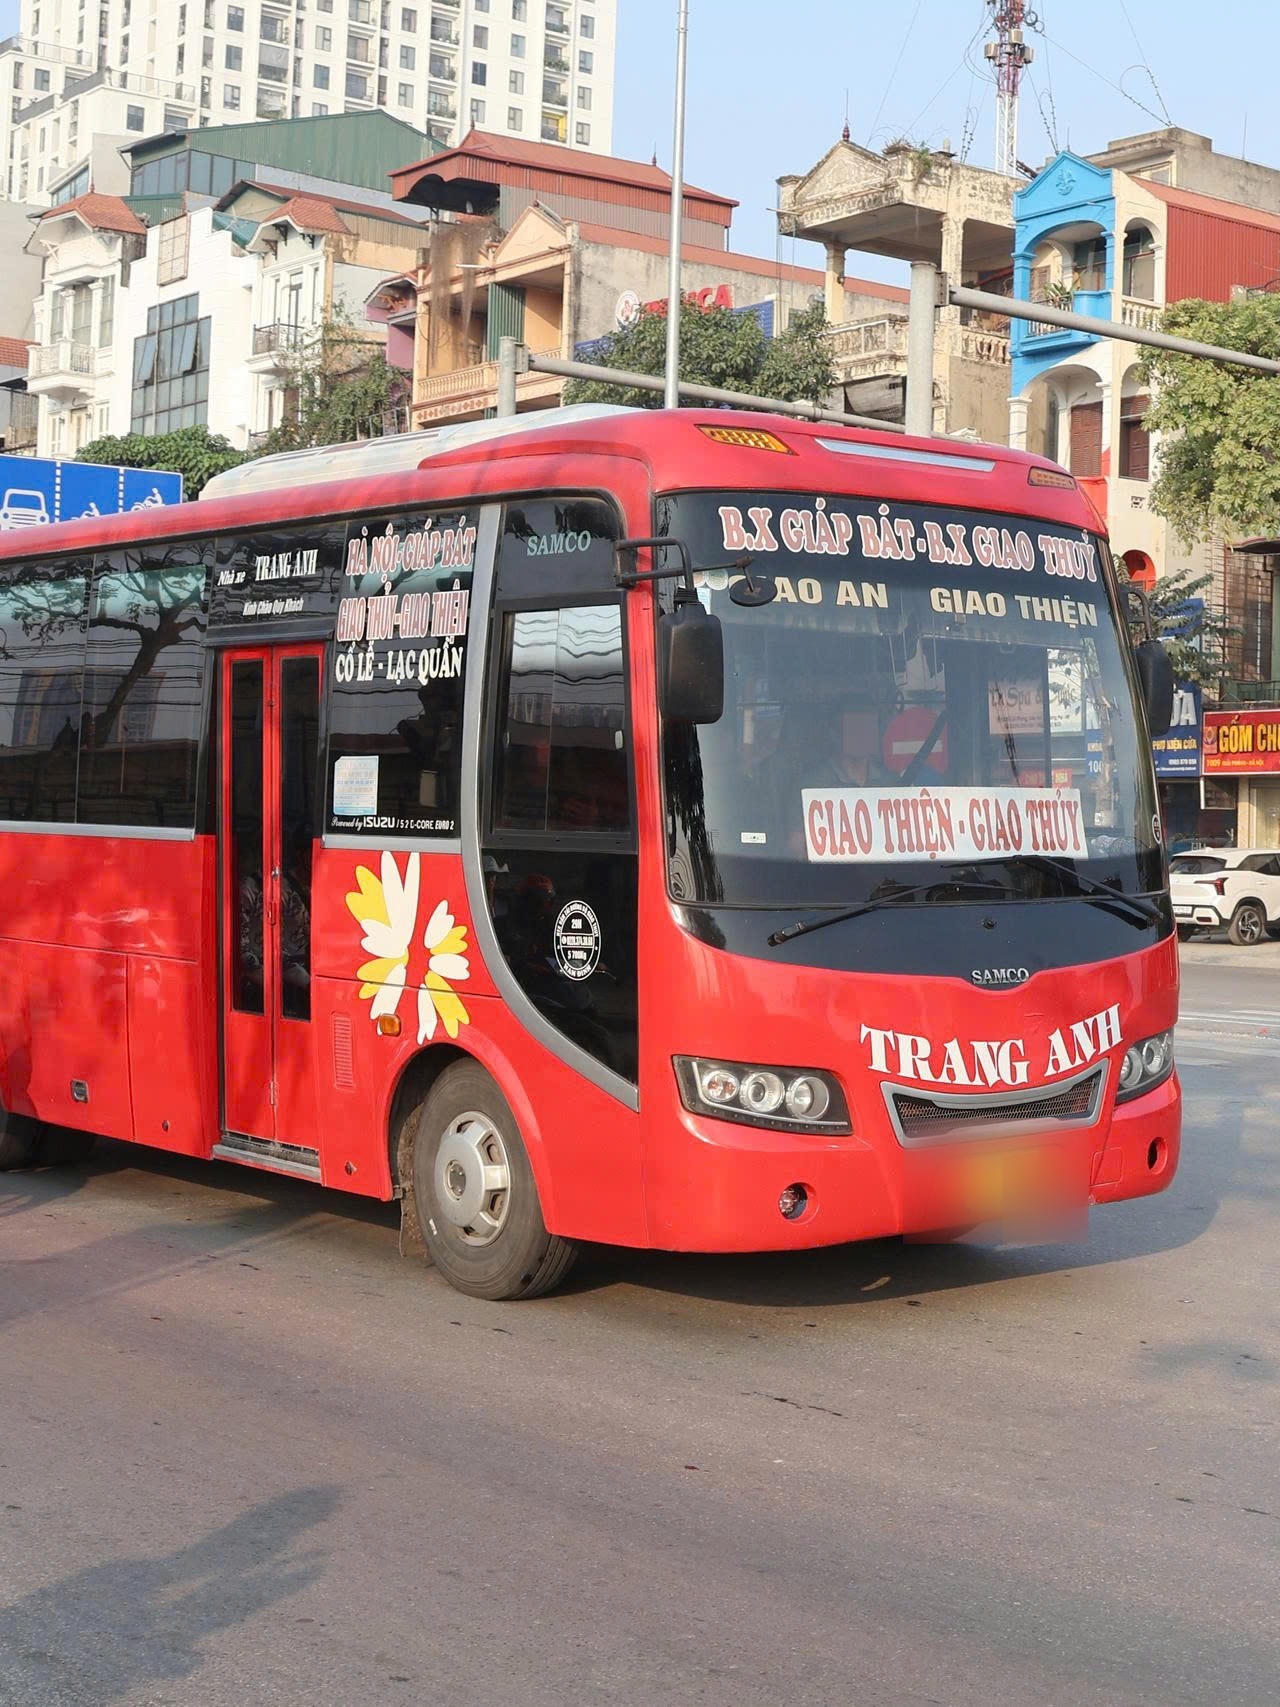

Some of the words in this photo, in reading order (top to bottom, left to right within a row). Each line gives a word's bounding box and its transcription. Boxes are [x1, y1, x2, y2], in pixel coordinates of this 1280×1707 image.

[345, 526, 368, 576] HÀ
[441, 515, 477, 568] BÁT
[526, 530, 592, 557] SAMCO
[718, 505, 779, 551] B.X
[779, 497, 854, 555] GIÁP
[972, 524, 1035, 571] GIAO
[217, 569, 235, 586] Nhà
[234, 571, 247, 584] xe
[254, 552, 293, 581] TRANG
[292, 548, 319, 577] ANH
[336, 596, 367, 642] GIAO
[430, 578, 470, 645] THIỆN
[836, 578, 889, 609] AN
[929, 586, 1006, 618] GIAO
[1014, 593, 1099, 629] THIỆN
[386, 650, 417, 685] LẠC
[1218, 714, 1254, 754] GỐM
[363, 816, 396, 828] ISUZU
[808, 797, 873, 857] GIAO
[877, 787, 955, 860] THIỆN
[968, 797, 1023, 853] GIAO
[971, 967, 1030, 985] SAMCO
[859, 1023, 1030, 1089] TRANG
[1044, 1002, 1124, 1077] ANH
